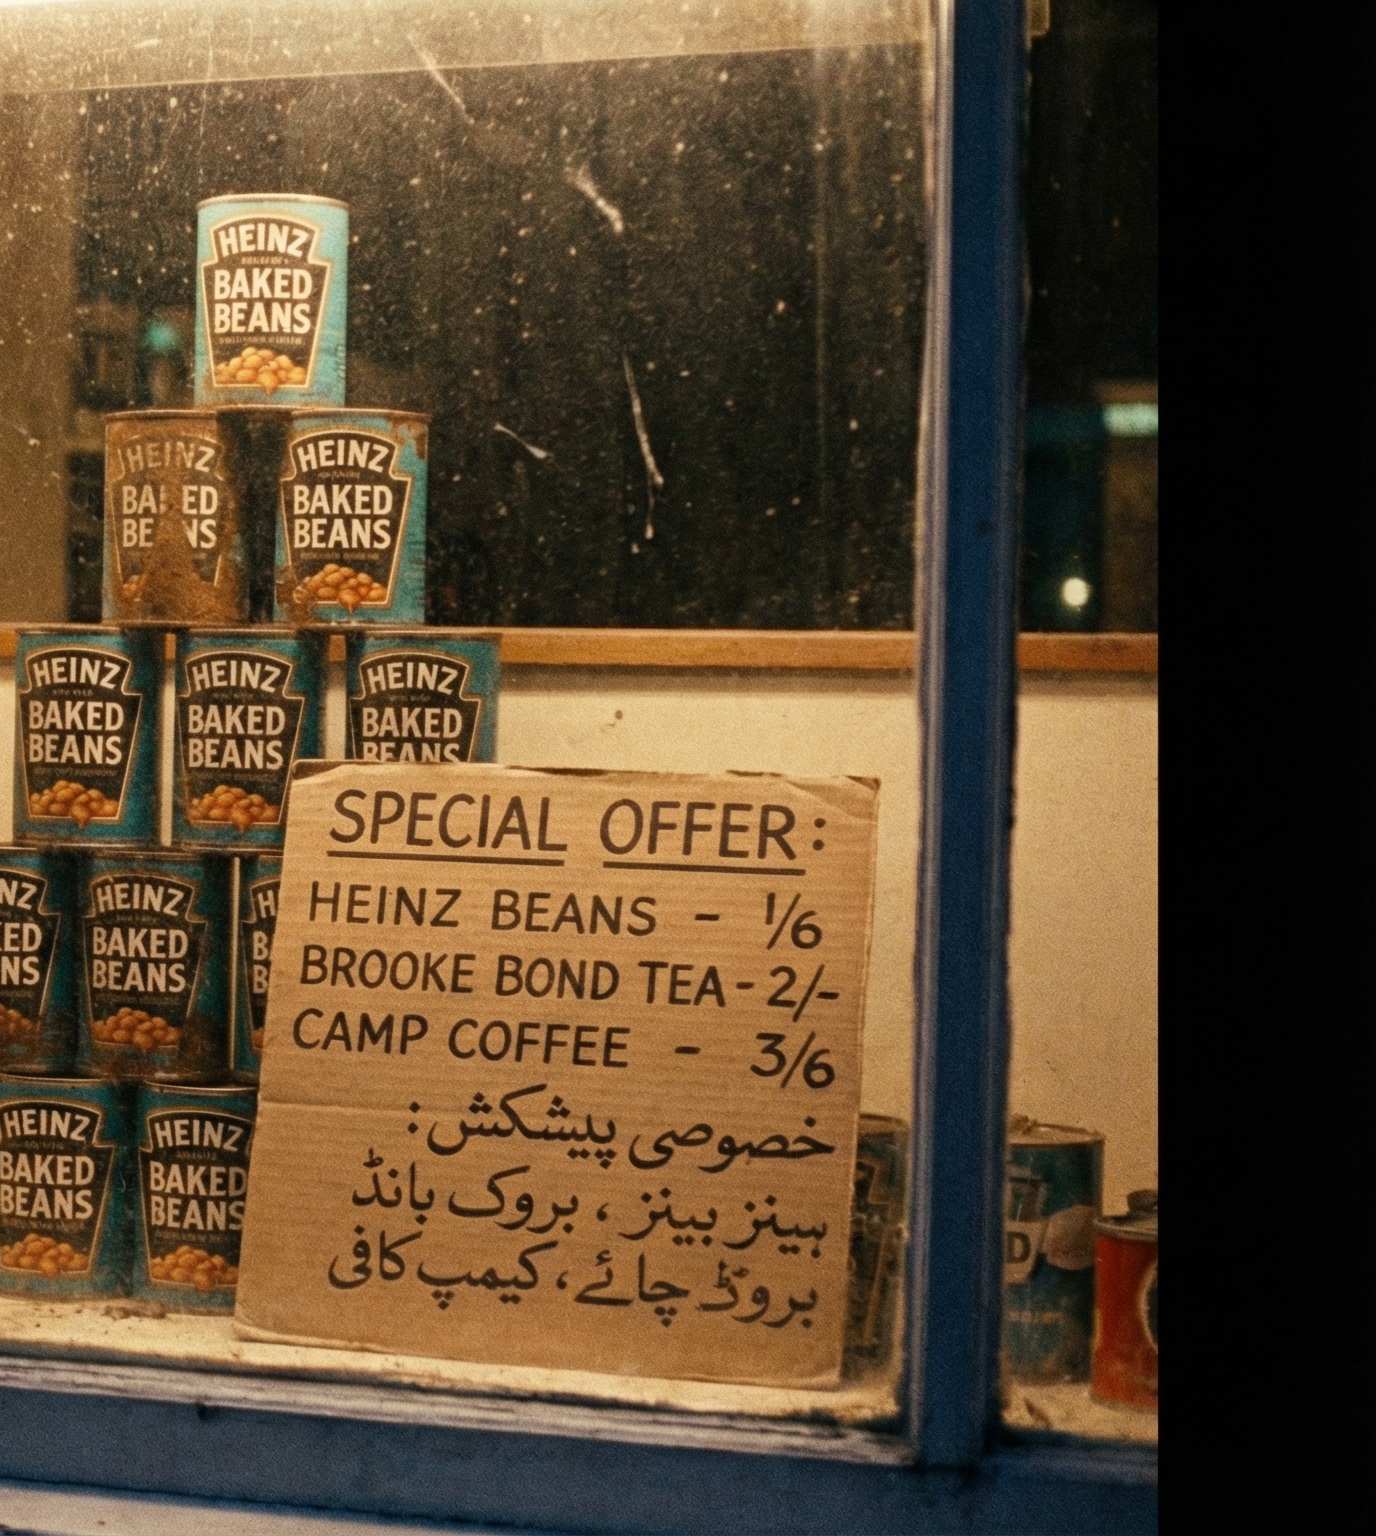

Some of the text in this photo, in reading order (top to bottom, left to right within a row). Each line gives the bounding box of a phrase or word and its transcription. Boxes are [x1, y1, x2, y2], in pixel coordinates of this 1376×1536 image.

[218, 222, 309, 257] HEINZ
[214, 268, 313, 300] BAKED
[214, 302, 311, 334] BEANS
[126, 441, 215, 473] HEINZ
[297, 439, 389, 473] HEINZ
[294, 485, 393, 516] BAKED
[122, 518, 217, 549] BENS
[294, 519, 391, 550] BEANS
[33, 656, 121, 690] HEINZ
[192, 660, 282, 693] HEINZ
[367, 662, 459, 695] HEINZ
[29, 701, 124, 732] BAKED
[188, 704, 286, 736] BAKED
[362, 707, 462, 738] BAKED
[29, 734, 123, 766] BEANS
[188, 738, 284, 770] BEANS
[329, 789, 568, 852] SPECIAL
[96, 883, 185, 917] HEINZ
[309, 881, 462, 928] HEINZ
[491, 889, 657, 936] BEANS
[765, 892, 822, 950] 1/6
[92, 926, 189, 959] BAKED
[92, 961, 187, 993] BEANS
[300, 944, 476, 994] BROOKE
[495, 954, 620, 1001] BOND
[292, 1008, 429, 1056] CAMP
[447, 1019, 631, 1068] COFFEE
[750, 1031, 836, 1089] 3/6
[3, 1109, 91, 1142] HEINZ
[154, 1119, 244, 1152] HEINZ
[629, 1116, 835, 1173] خصوصی
[149, 1160, 247, 1197] BAKED
[352, 1147, 435, 1225] بانڈ
[0, 1185, 94, 1220] BEANS
[150, 1195, 245, 1231] BEANS
[448, 1165, 579, 1235] بروک
[328, 1224, 424, 1290] کافی
[417, 1240, 559, 1310] کیمپ
